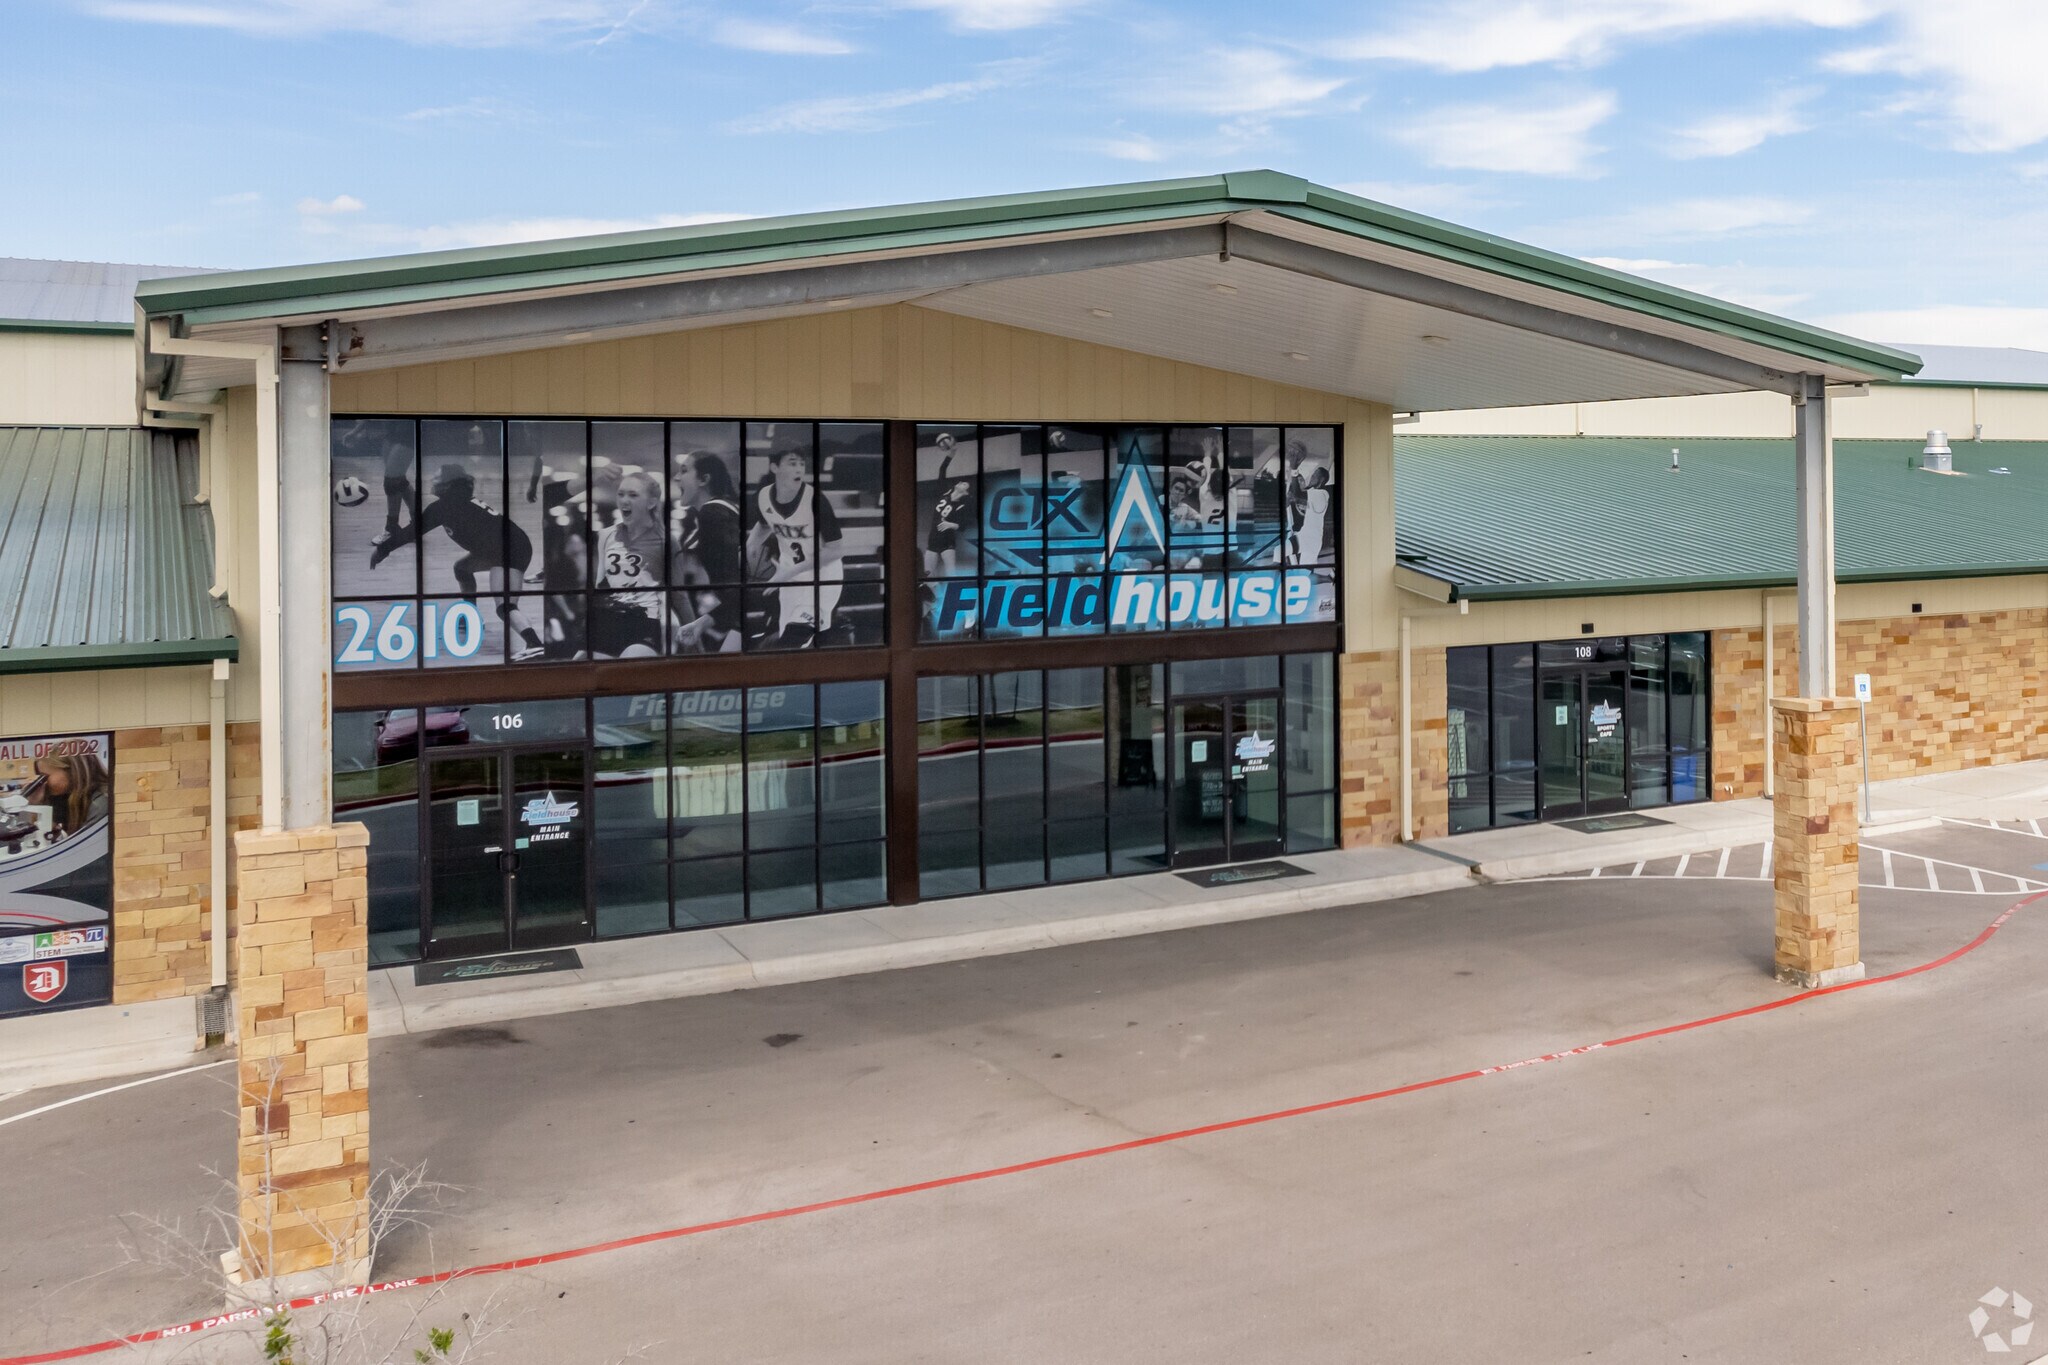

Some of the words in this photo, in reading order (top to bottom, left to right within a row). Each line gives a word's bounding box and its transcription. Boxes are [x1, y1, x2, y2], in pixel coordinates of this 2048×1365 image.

[790, 542, 805, 565] 3
[606, 553, 643, 577] 33
[937, 569, 1311, 631] Fieldhouse
[335, 601, 484, 664] 2610
[1575, 646, 1592, 659] 108
[627, 690, 786, 718] Fieldhouse
[492, 713, 523, 730] 106
[0, 743, 29, 760] ALL
[34, 743, 53, 758] OF
[58, 739, 99, 758] 2022
[530, 832, 570, 842] ENTRANCE
[540, 825, 561, 833] MAIN
[36, 948, 62, 958] STEM
[162, 1325, 191, 1338] NO
[368, 1279, 419, 1293] LANE
